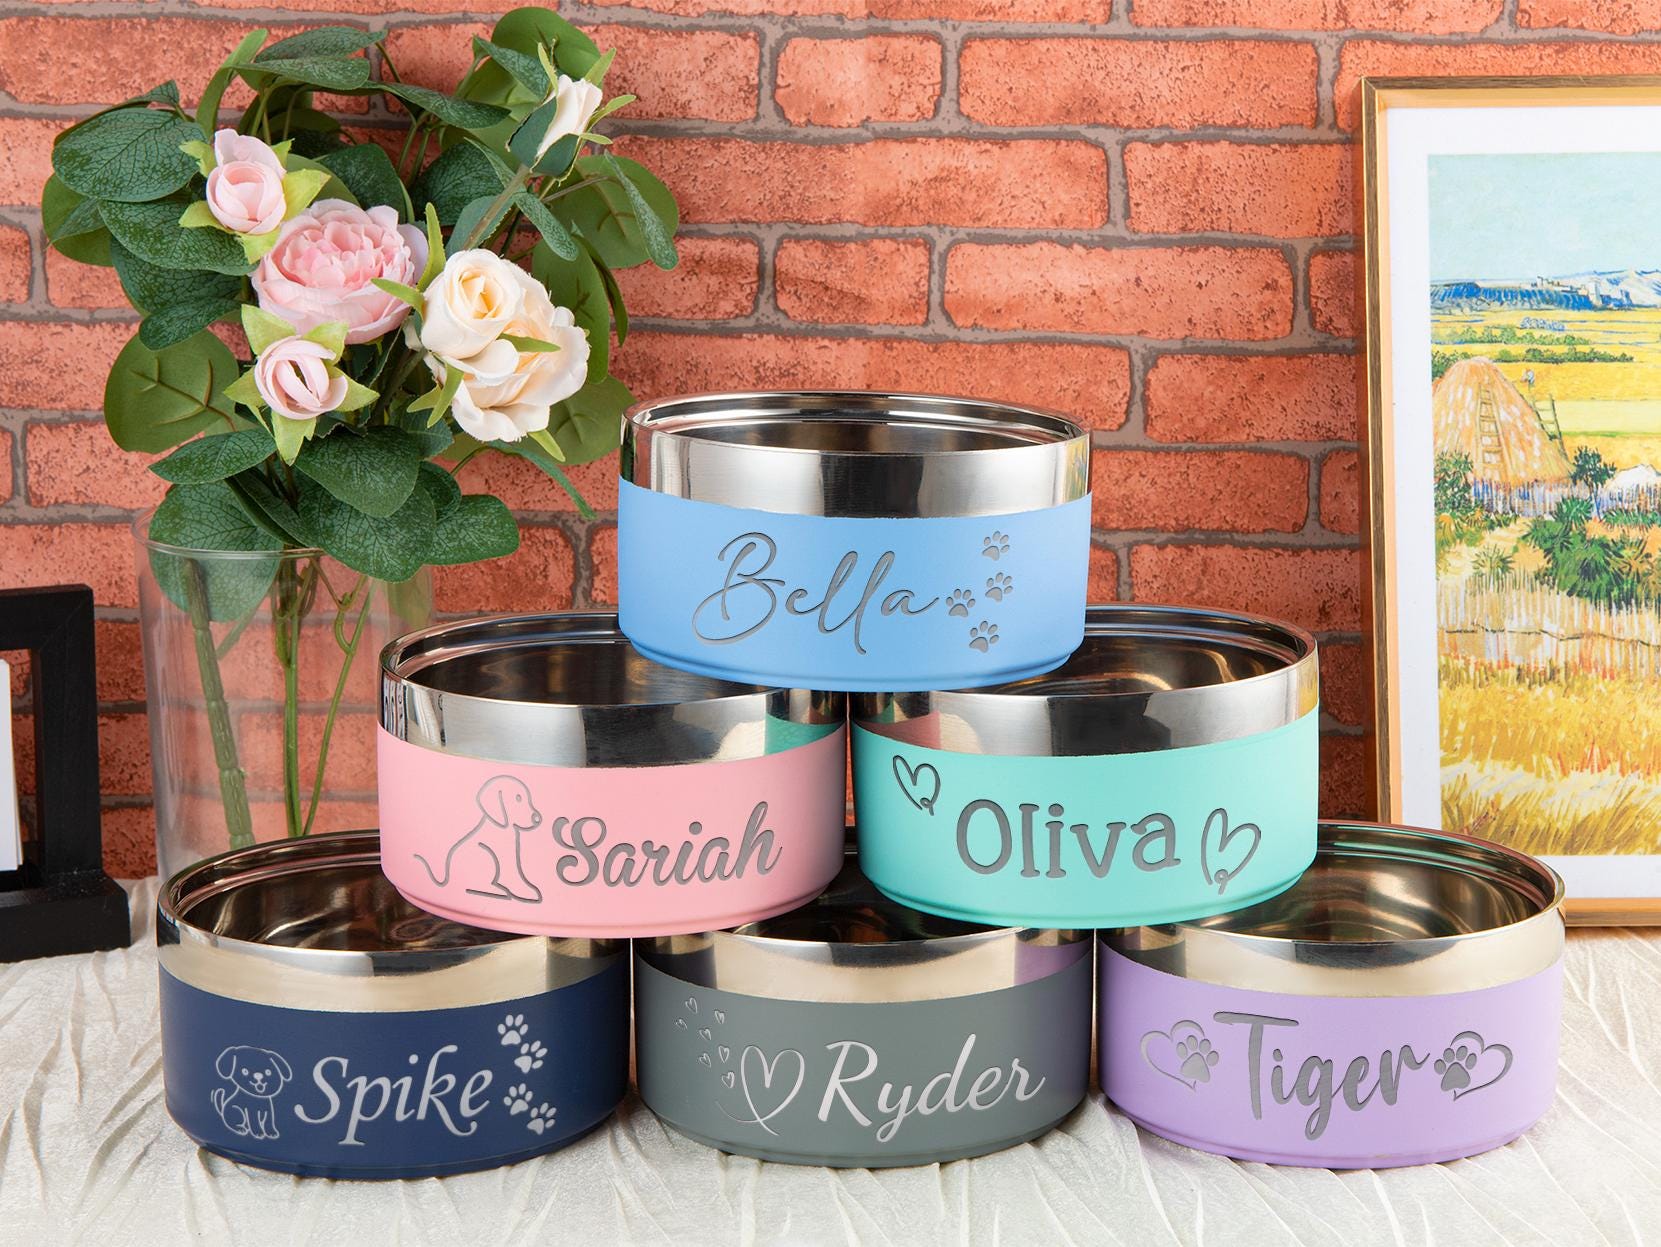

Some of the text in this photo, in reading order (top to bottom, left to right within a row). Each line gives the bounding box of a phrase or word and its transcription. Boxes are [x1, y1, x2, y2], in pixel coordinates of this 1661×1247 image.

[692, 532, 939, 655] Bella
[552, 801, 782, 887] Sariah
[956, 799, 1181, 879] Oliva
[294, 1044, 493, 1146] Spike
[817, 1033, 1046, 1143] Ryder
[1213, 1011, 1430, 1141] Tiger
